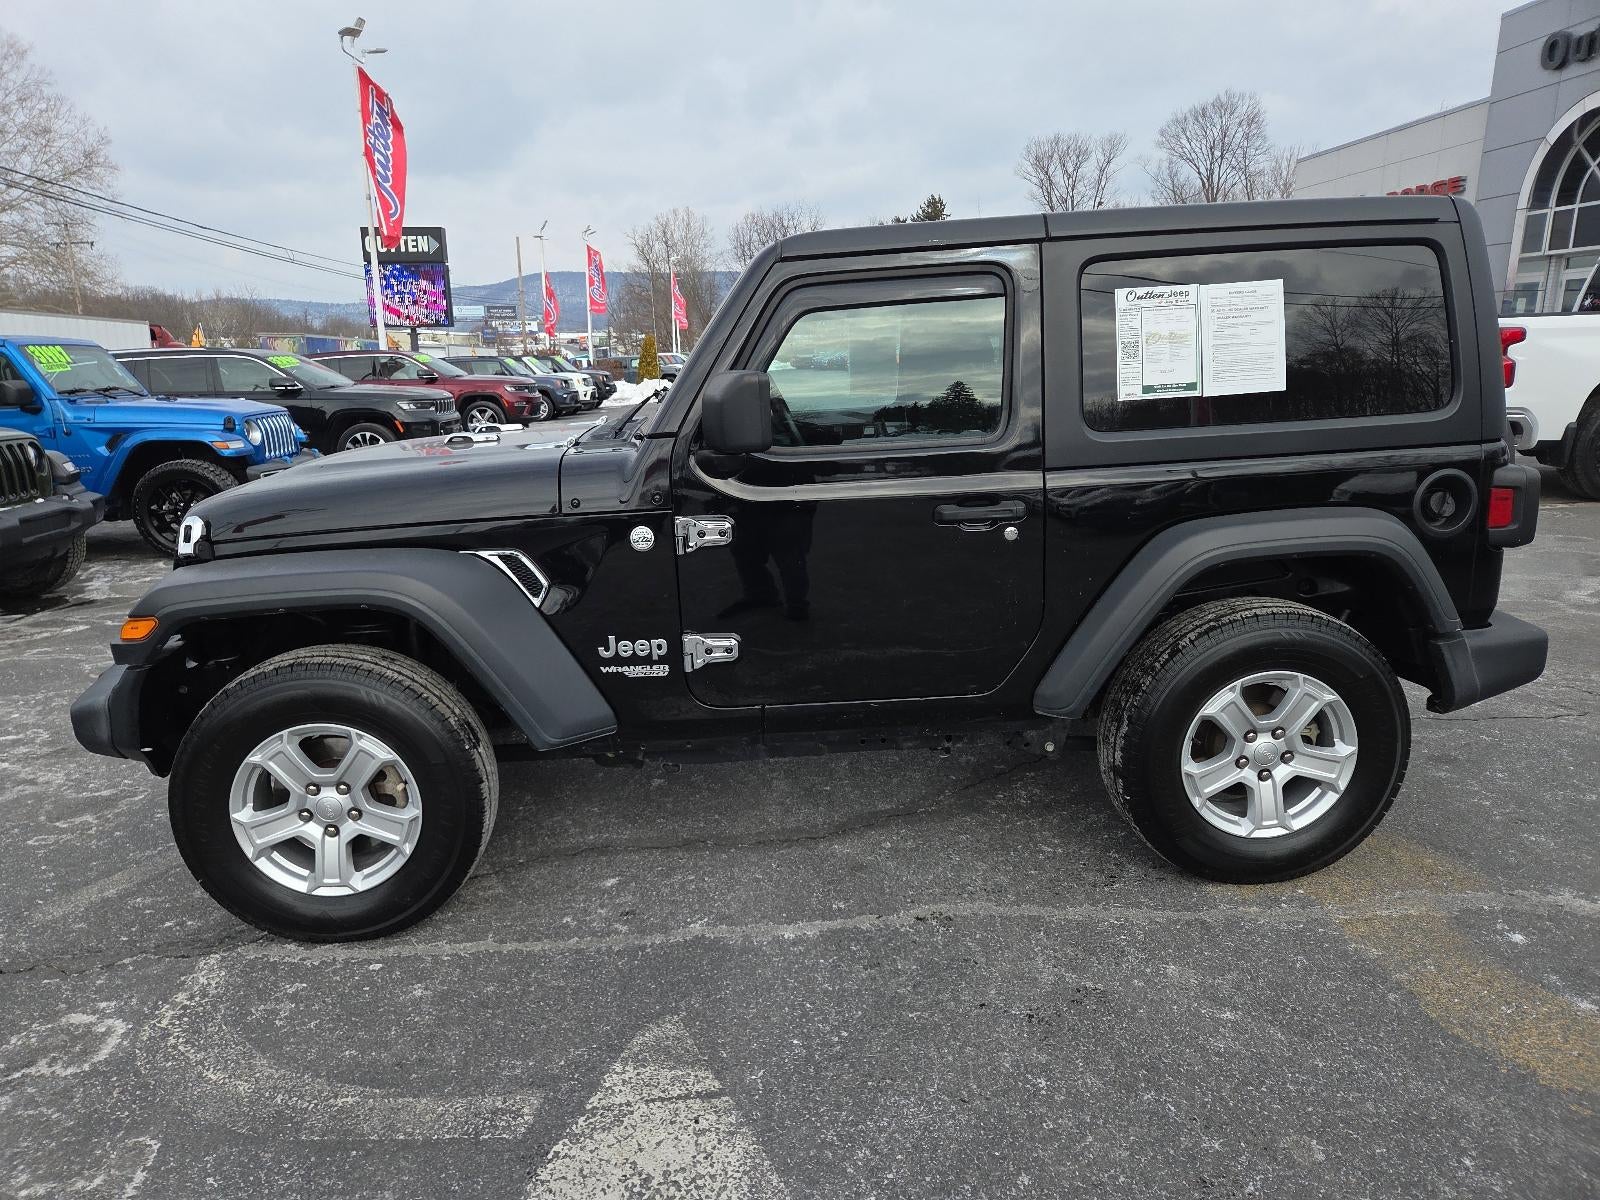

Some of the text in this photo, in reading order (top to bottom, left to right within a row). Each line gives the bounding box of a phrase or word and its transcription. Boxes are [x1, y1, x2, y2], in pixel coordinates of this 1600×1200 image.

[1387, 175, 1468, 195] DGE
[365, 236, 429, 252] OUTEN
[1126, 290, 1190, 302] Outten Jeep
[598, 635, 668, 661] Jeep
[600, 665, 670, 673] WRANGLER
